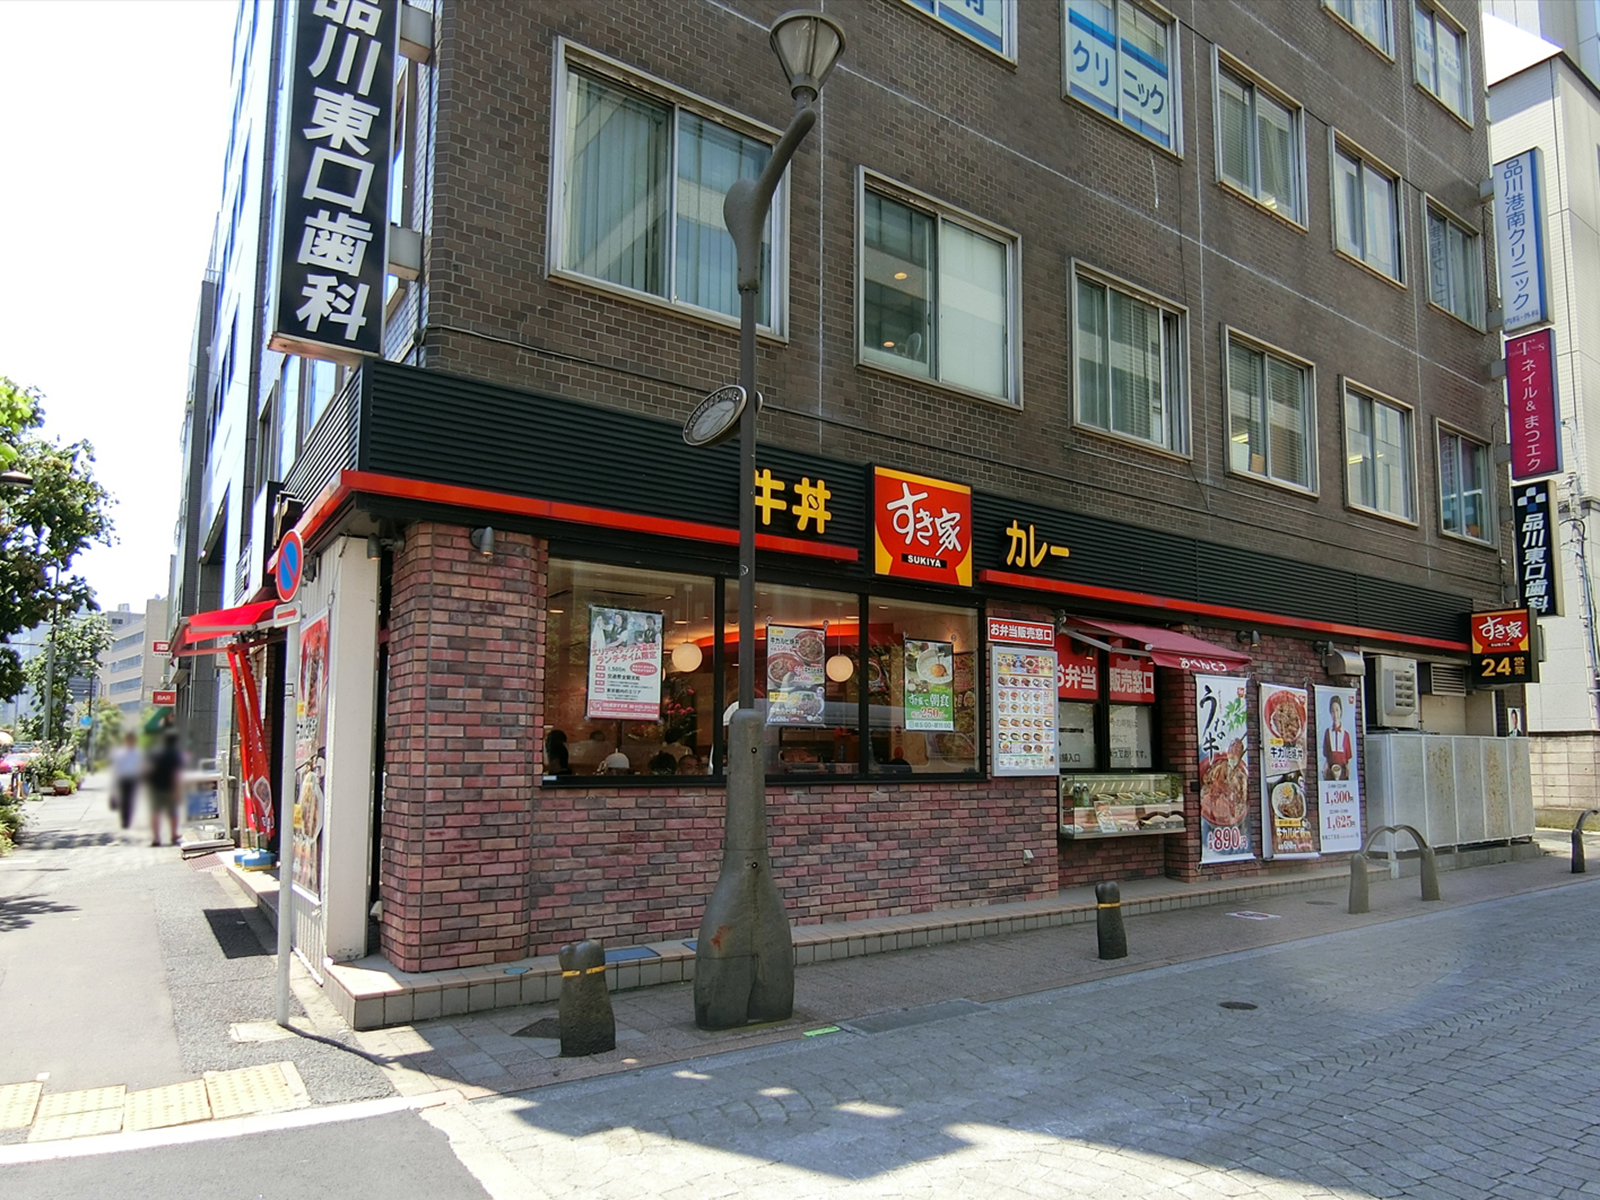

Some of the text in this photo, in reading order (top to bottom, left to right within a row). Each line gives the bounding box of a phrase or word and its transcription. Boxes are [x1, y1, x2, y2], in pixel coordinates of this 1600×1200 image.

[1073, 40, 1164, 114] クリニック
[296, 0, 382, 341] 品川東口歯科
[1504, 159, 1530, 311] 品川港南クリニック
[1505, 309, 1539, 325] 内科・外科
[755, 468, 832, 534] 牛丼
[886, 481, 963, 556] すき家
[907, 554, 942, 568] SUKIYA
[1006, 519, 1070, 568] カレー
[1522, 513, 1549, 613] 品川東口歯科
[990, 623, 1053, 641] お弁当販売窓口
[1478, 616, 1523, 642] すき家
[1109, 669, 1155, 694] 販売窓口
[1179, 656, 1227, 672] おべんとう
[1481, 657, 1512, 676] 24
